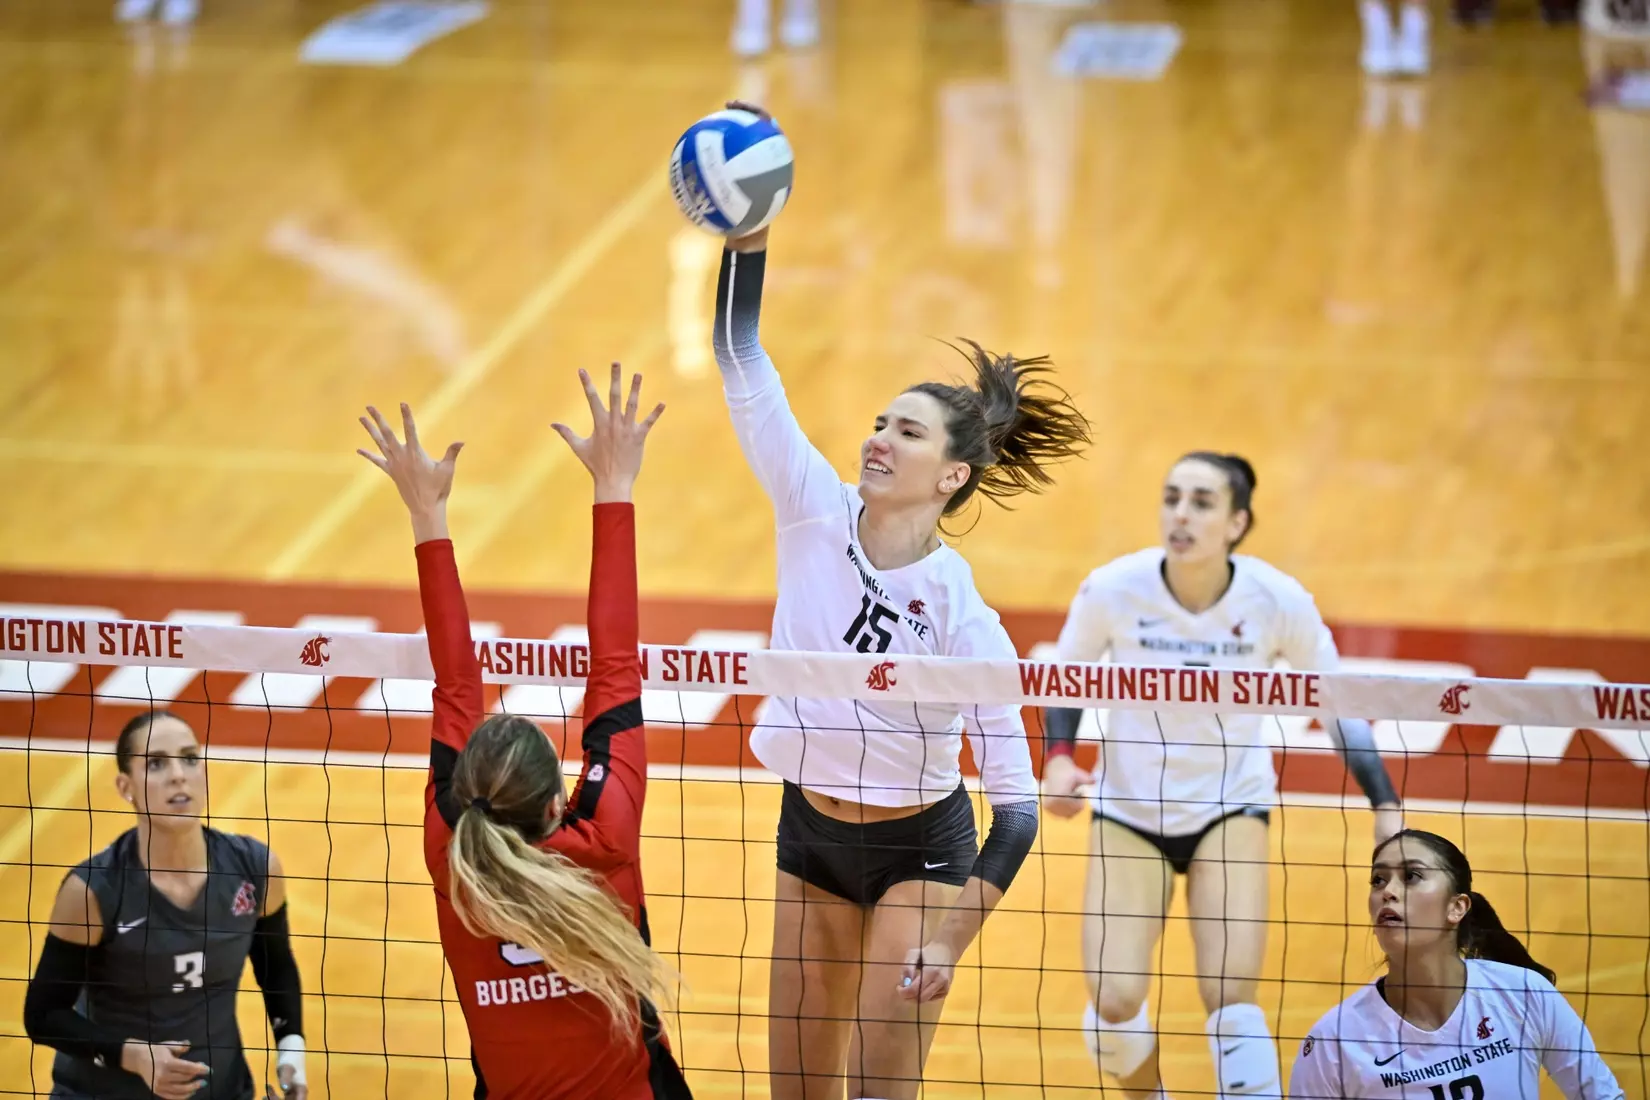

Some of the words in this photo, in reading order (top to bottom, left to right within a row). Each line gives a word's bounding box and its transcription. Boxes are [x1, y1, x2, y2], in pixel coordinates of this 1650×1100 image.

[98, 621, 183, 658] STATE
[842, 591, 900, 654] 15
[661, 648, 748, 685] STATE
[1018, 662, 1220, 703] WASHINGTON
[1232, 671, 1320, 707] STATE
[172, 951, 206, 993] 3
[1379, 1053, 1473, 1089] WASHINGTON
[1472, 1037, 1514, 1065] STATE
